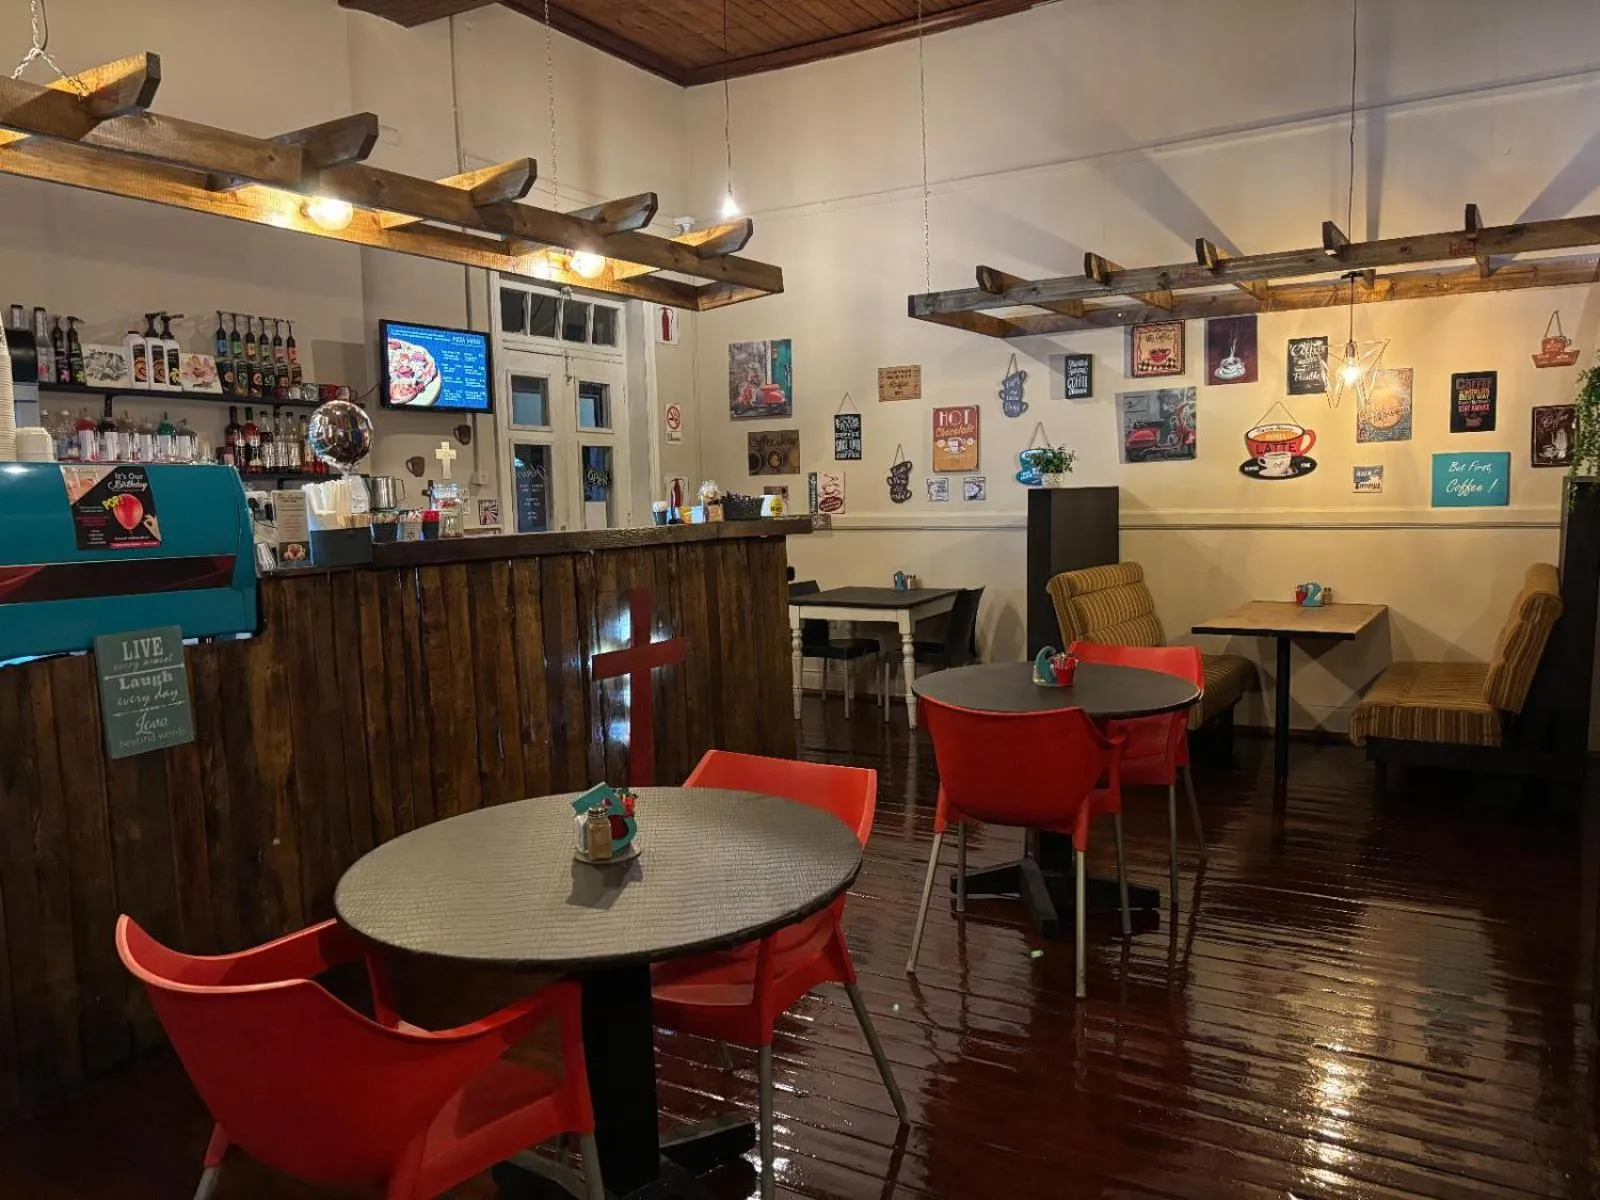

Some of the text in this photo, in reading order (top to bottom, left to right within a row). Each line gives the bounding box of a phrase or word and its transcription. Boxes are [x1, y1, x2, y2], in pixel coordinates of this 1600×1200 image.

[938, 409, 970, 427] HOT
[936, 424, 974, 438] Chocolate
[1256, 442, 1297, 455] LATTE
[1448, 462, 1466, 473] But
[107, 479, 148, 492] Birthday
[1445, 479, 1499, 497] Coffee !
[121, 636, 164, 661] LIVE
[119, 670, 174, 690] Laugh
[117, 684, 178, 708] every day
